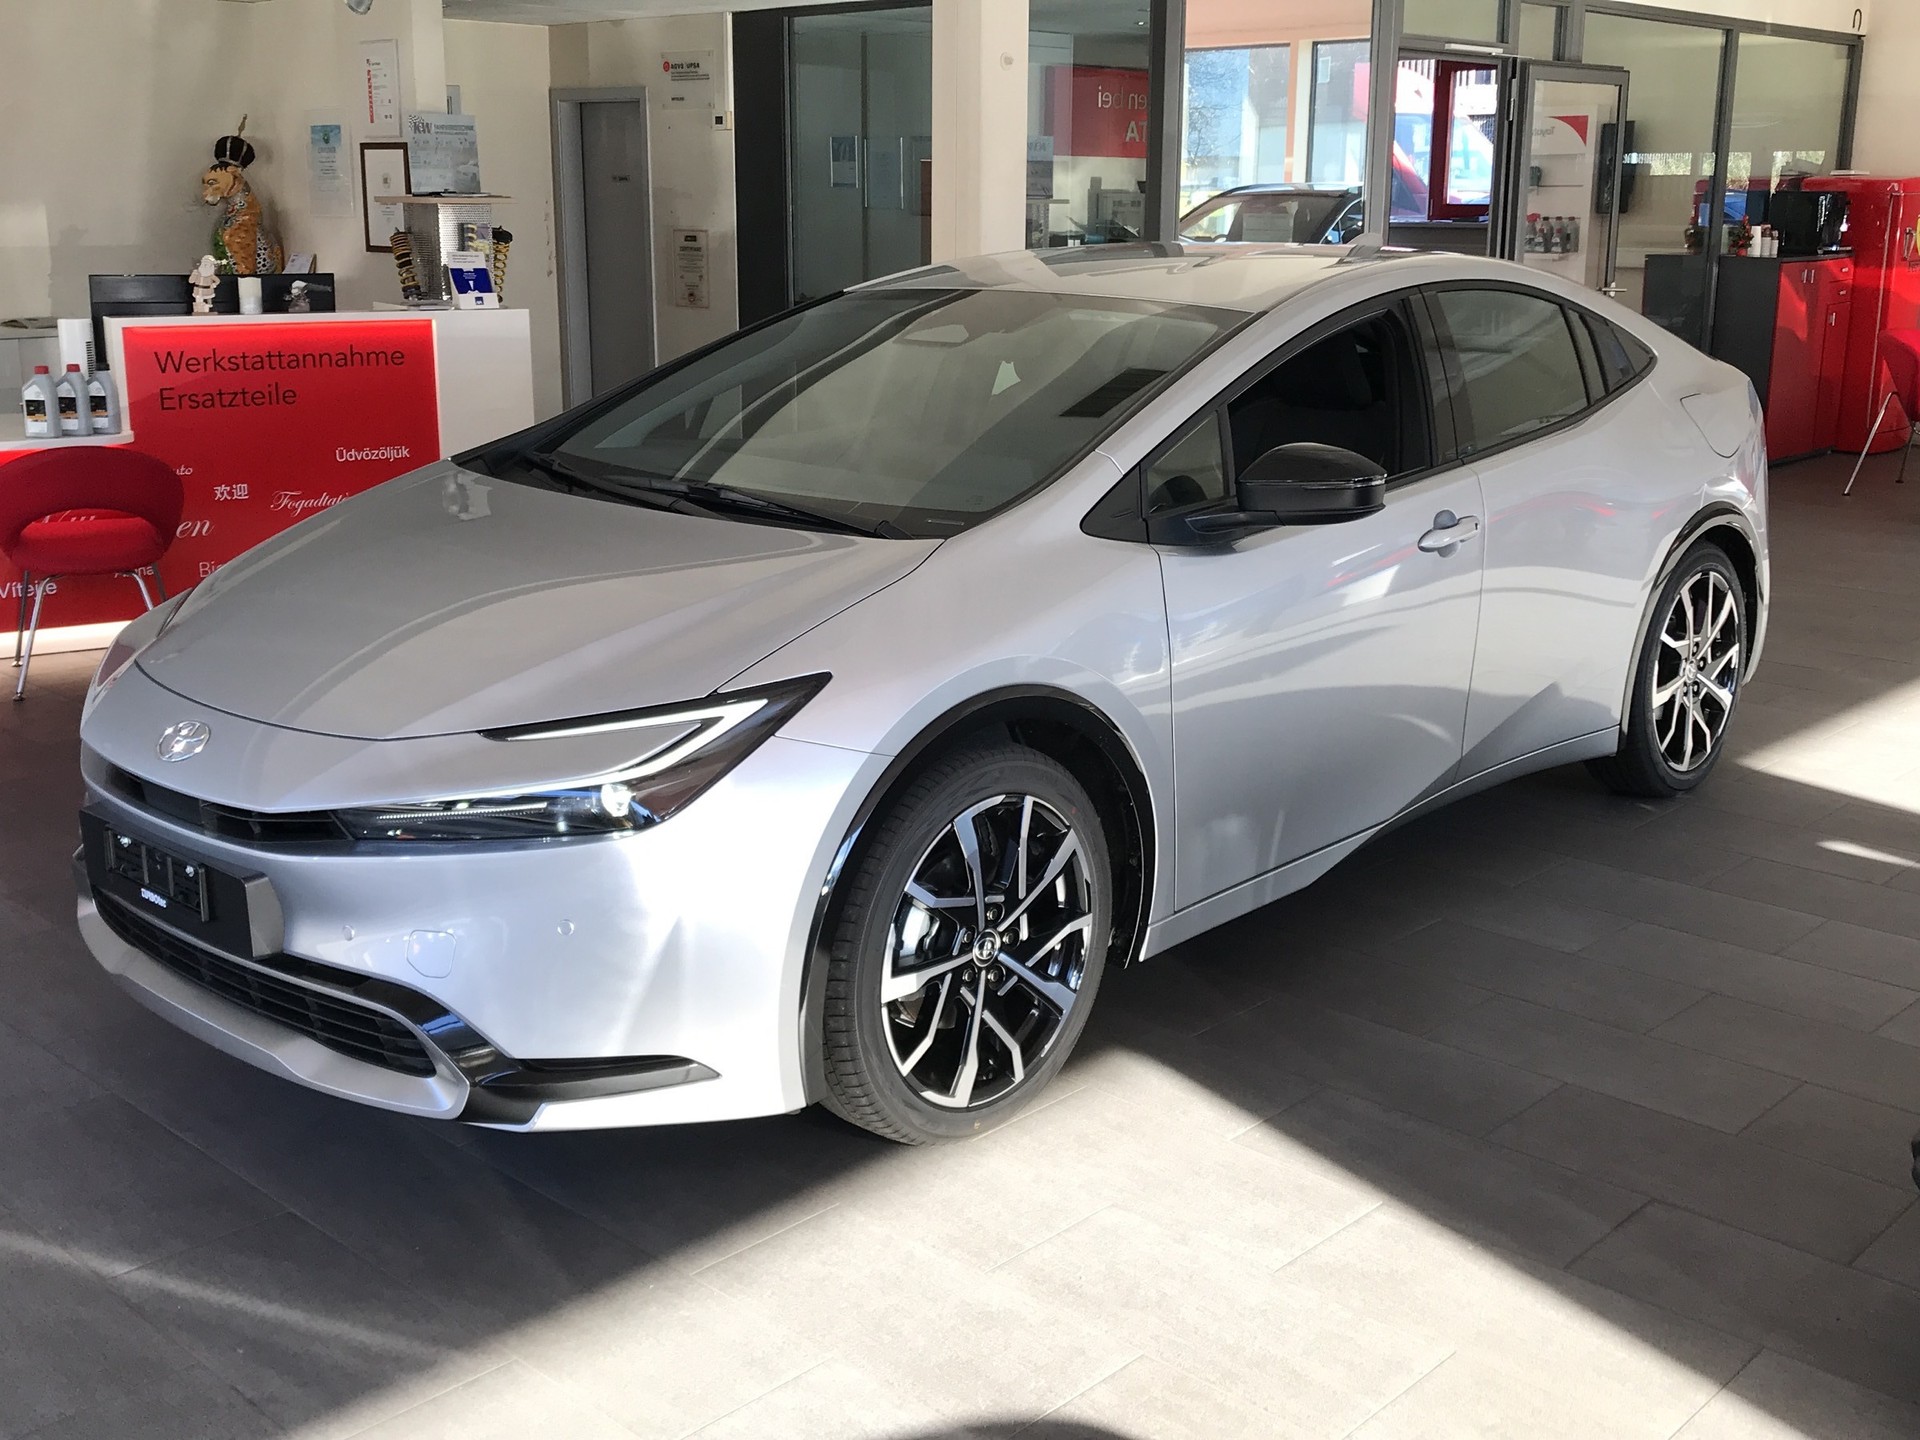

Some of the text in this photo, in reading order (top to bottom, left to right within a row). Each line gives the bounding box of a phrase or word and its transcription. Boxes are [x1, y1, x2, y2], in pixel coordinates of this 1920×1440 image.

[153, 345, 405, 374] Werkstattannahme
[159, 382, 297, 411] Ersatzteile
[335, 446, 410, 462] Üdvözöljük
[213, 483, 249, 501] 欢迎
[199, 560, 223, 577] Bi
[0, 580, 57, 600] Víteje
